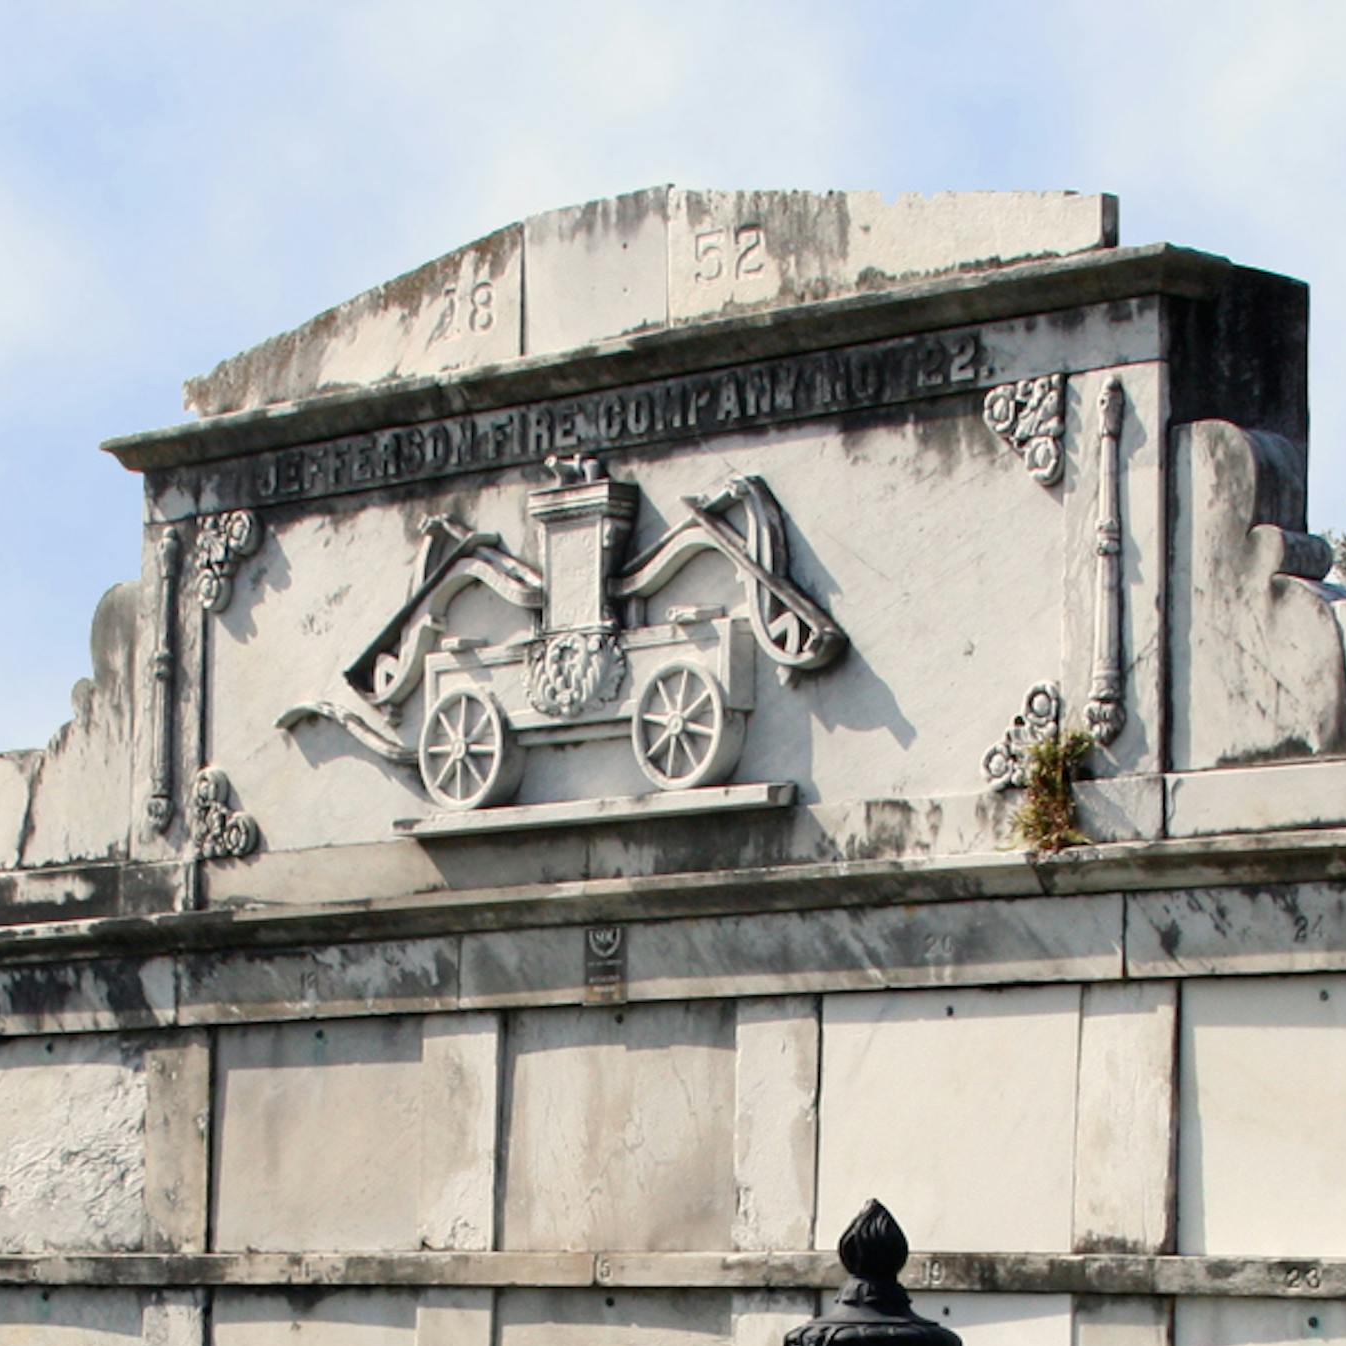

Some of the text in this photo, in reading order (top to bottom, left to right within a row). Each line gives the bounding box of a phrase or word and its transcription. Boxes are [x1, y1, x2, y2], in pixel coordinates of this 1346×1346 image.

[694, 222, 765, 283] 52
[258, 417, 479, 498] JEFFERSON
[487, 404, 579, 459] FIRE
[1293, 914, 1324, 943] 24
[921, 1260, 945, 1285] 19
[1284, 1266, 1321, 1290] 23
